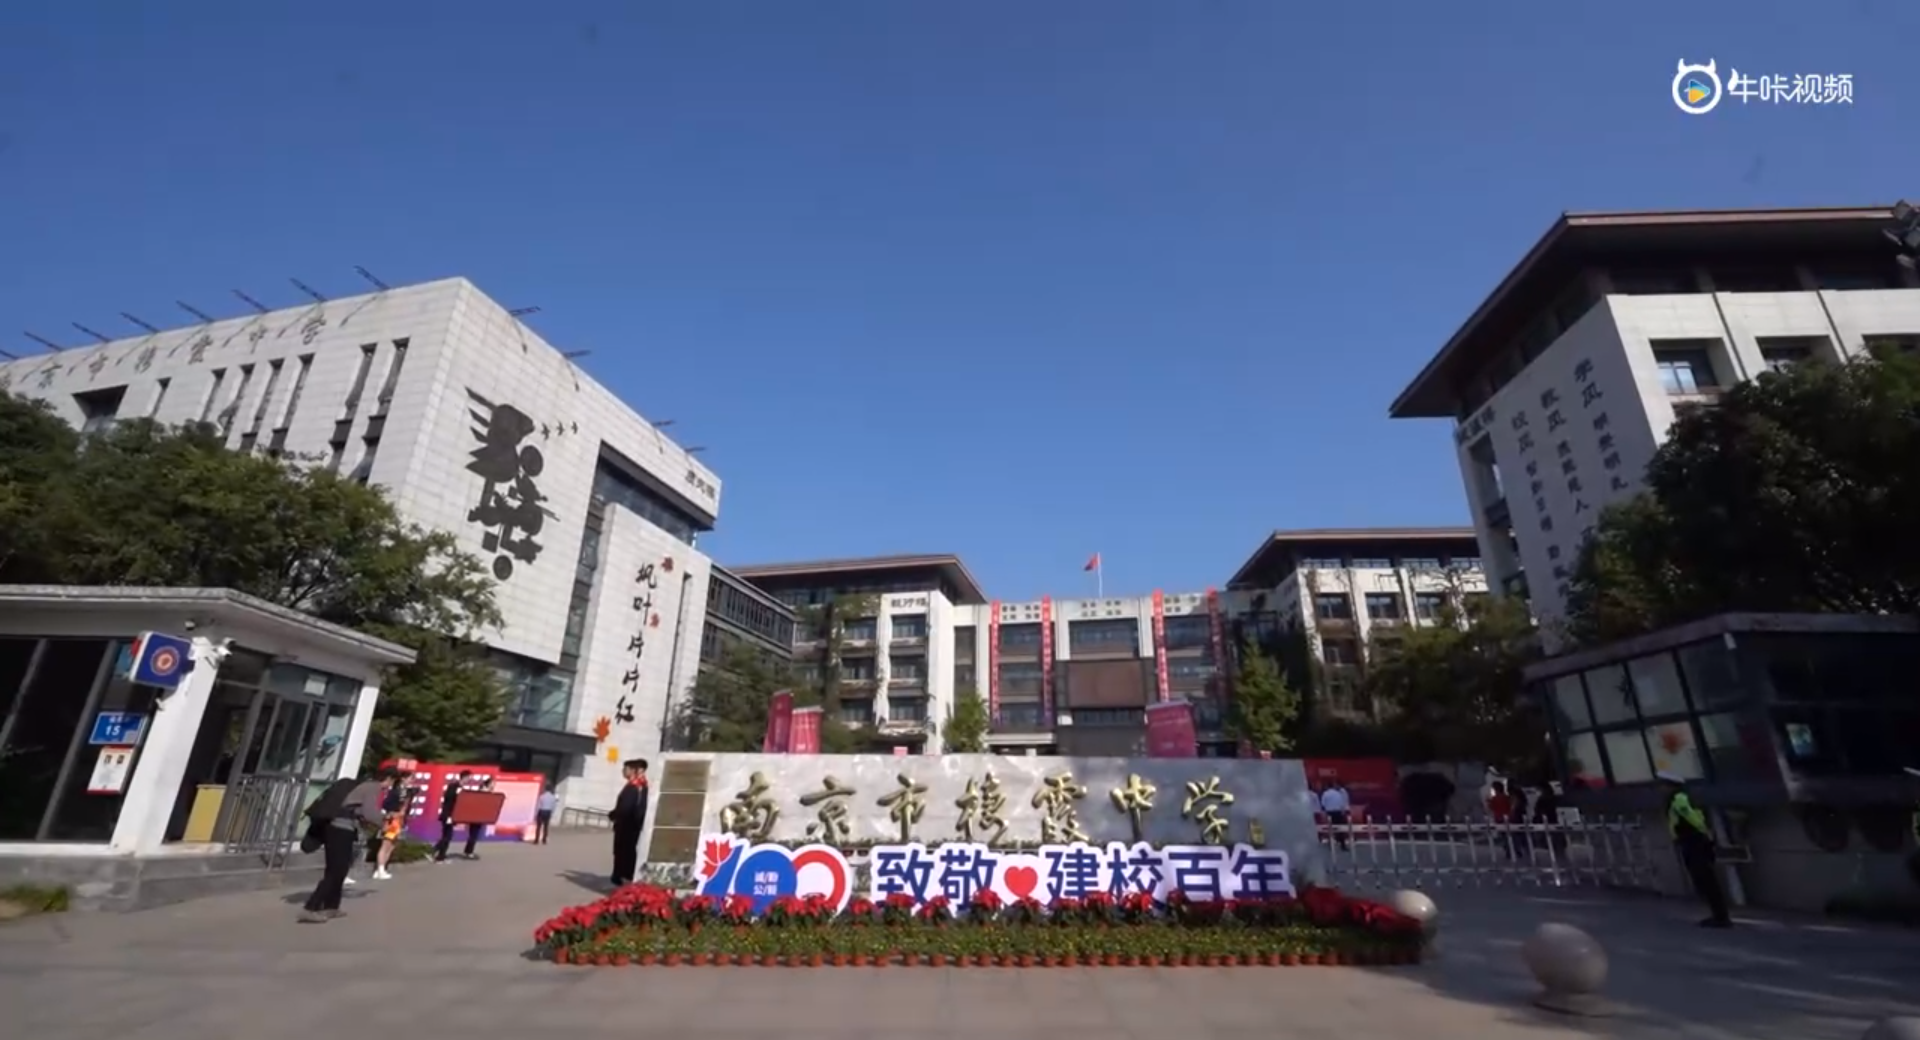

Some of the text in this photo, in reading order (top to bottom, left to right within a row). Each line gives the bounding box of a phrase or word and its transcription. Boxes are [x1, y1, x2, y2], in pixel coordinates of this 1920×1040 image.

[615, 562, 658, 725] 枫叶片片红
[105, 725, 121, 736] 15
[876, 848, 1290, 910] 致敬 建校百年
